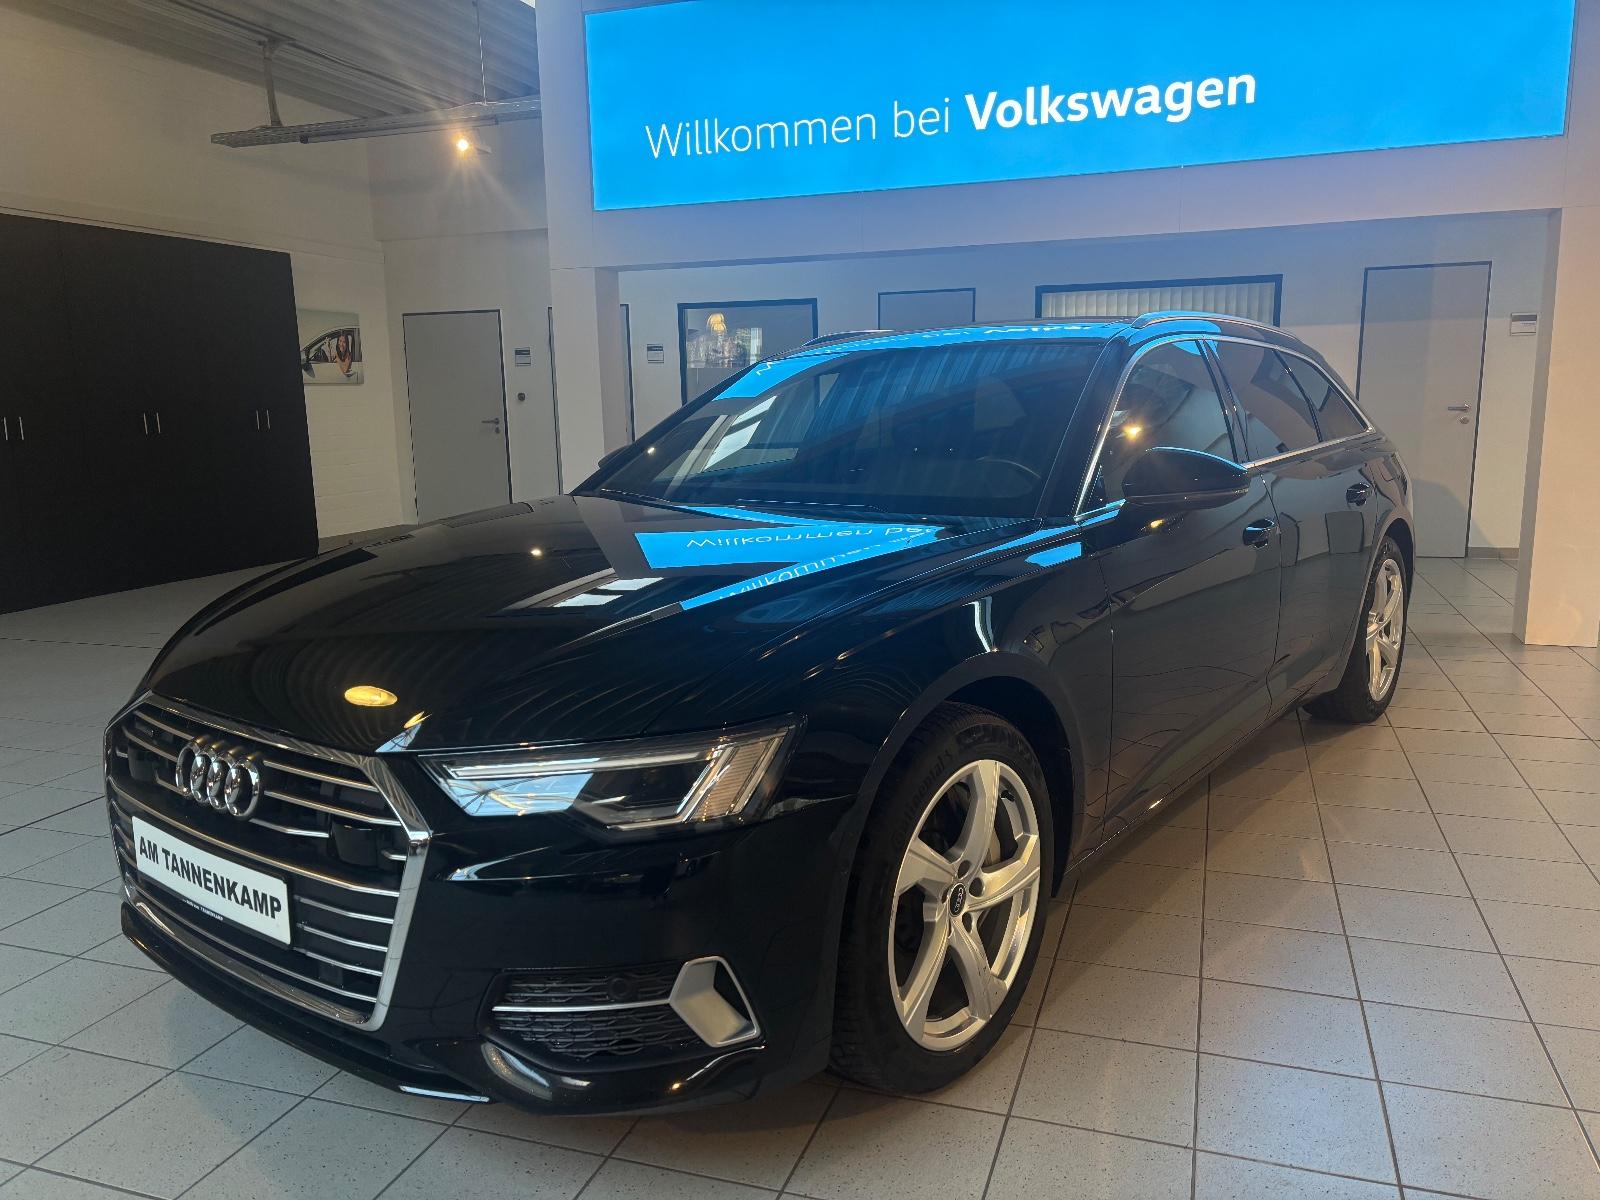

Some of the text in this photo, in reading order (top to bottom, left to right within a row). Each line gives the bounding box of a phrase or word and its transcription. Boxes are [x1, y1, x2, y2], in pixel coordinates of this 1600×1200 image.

[646, 73, 1257, 159] Willkommen bei Volkswagen
[139, 836, 159, 865] AM
[162, 847, 282, 919] TANNENKAMP
